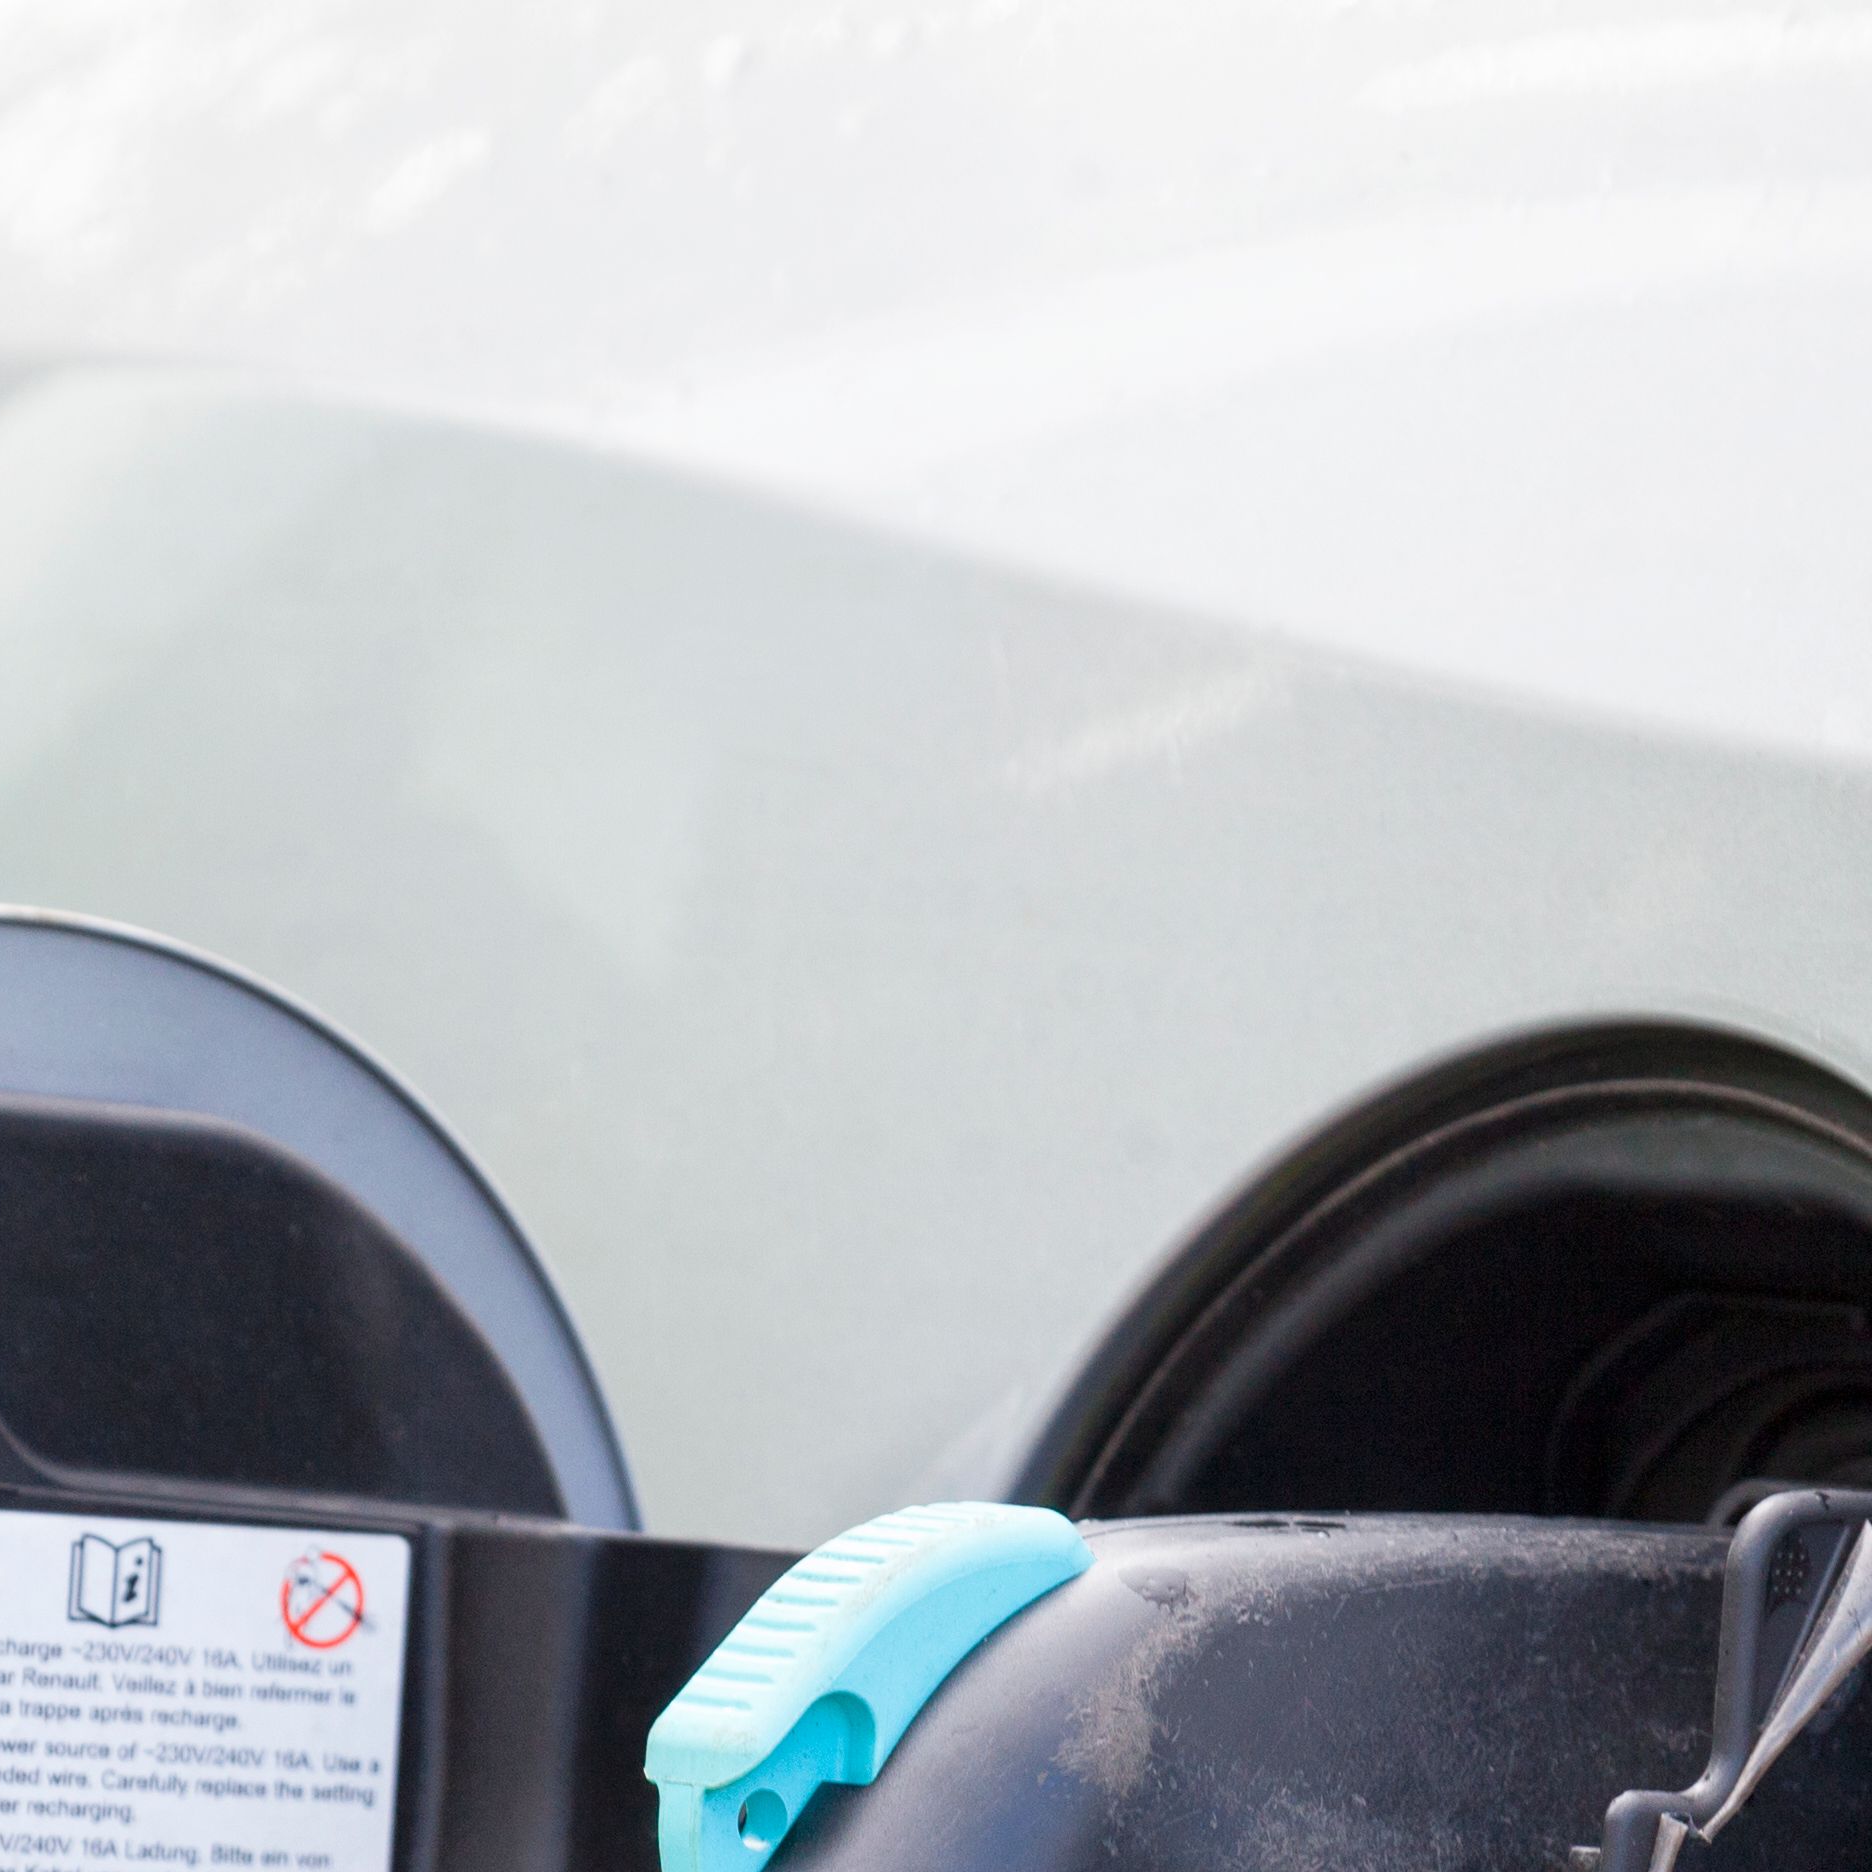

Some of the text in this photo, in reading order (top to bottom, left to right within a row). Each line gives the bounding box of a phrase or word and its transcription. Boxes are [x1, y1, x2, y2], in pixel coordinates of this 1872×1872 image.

[251, 1653, 321, 1674] Utilisez
[328, 1661, 352, 1675] un
[112, 1674, 176, 1696] Veillez
[201, 1680, 242, 1698] bien
[250, 1682, 332, 1704] refermer
[339, 1690, 356, 1706] le
[19, 1699, 81, 1722] trappe
[44, 1741, 111, 1759] source
[117, 1742, 137, 1761] of
[323, 1755, 361, 1773] Use
[367, 1758, 381, 1774] a
[100, 1769, 188, 1796] Carefully
[195, 1778, 267, 1798] replace
[273, 1780, 304, 1799] the
[311, 1783, 375, 1809] setting
[210, 1843, 254, 1865] Bitte
[259, 1850, 289, 1866] ein
[296, 1853, 330, 1868] von
